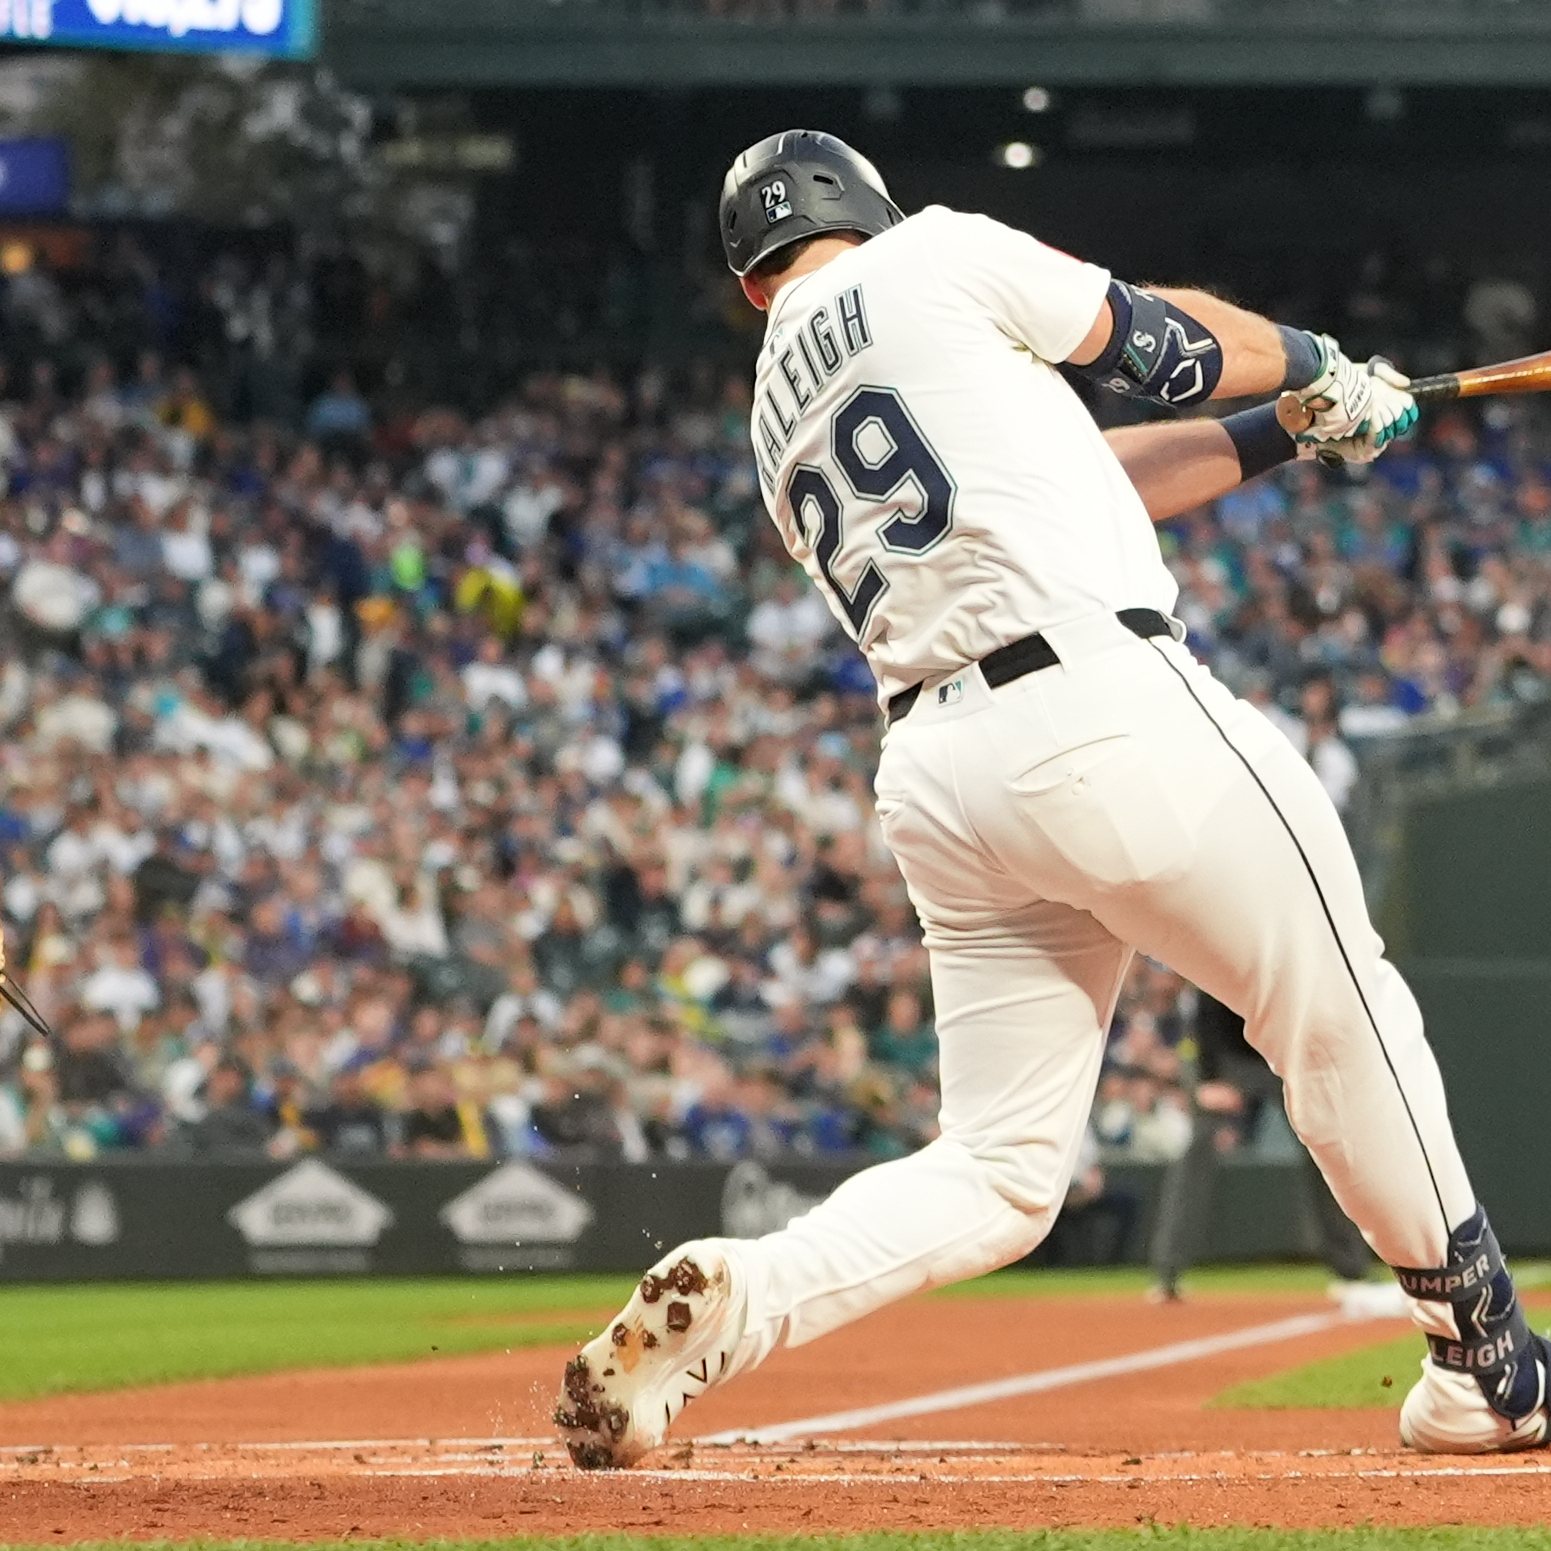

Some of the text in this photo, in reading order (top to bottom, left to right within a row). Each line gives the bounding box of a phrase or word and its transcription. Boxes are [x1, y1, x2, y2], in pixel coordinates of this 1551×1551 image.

[761, 181, 786, 208] 29
[785, 383, 958, 646] 29
[1399, 1254, 1490, 1292] UMPER
